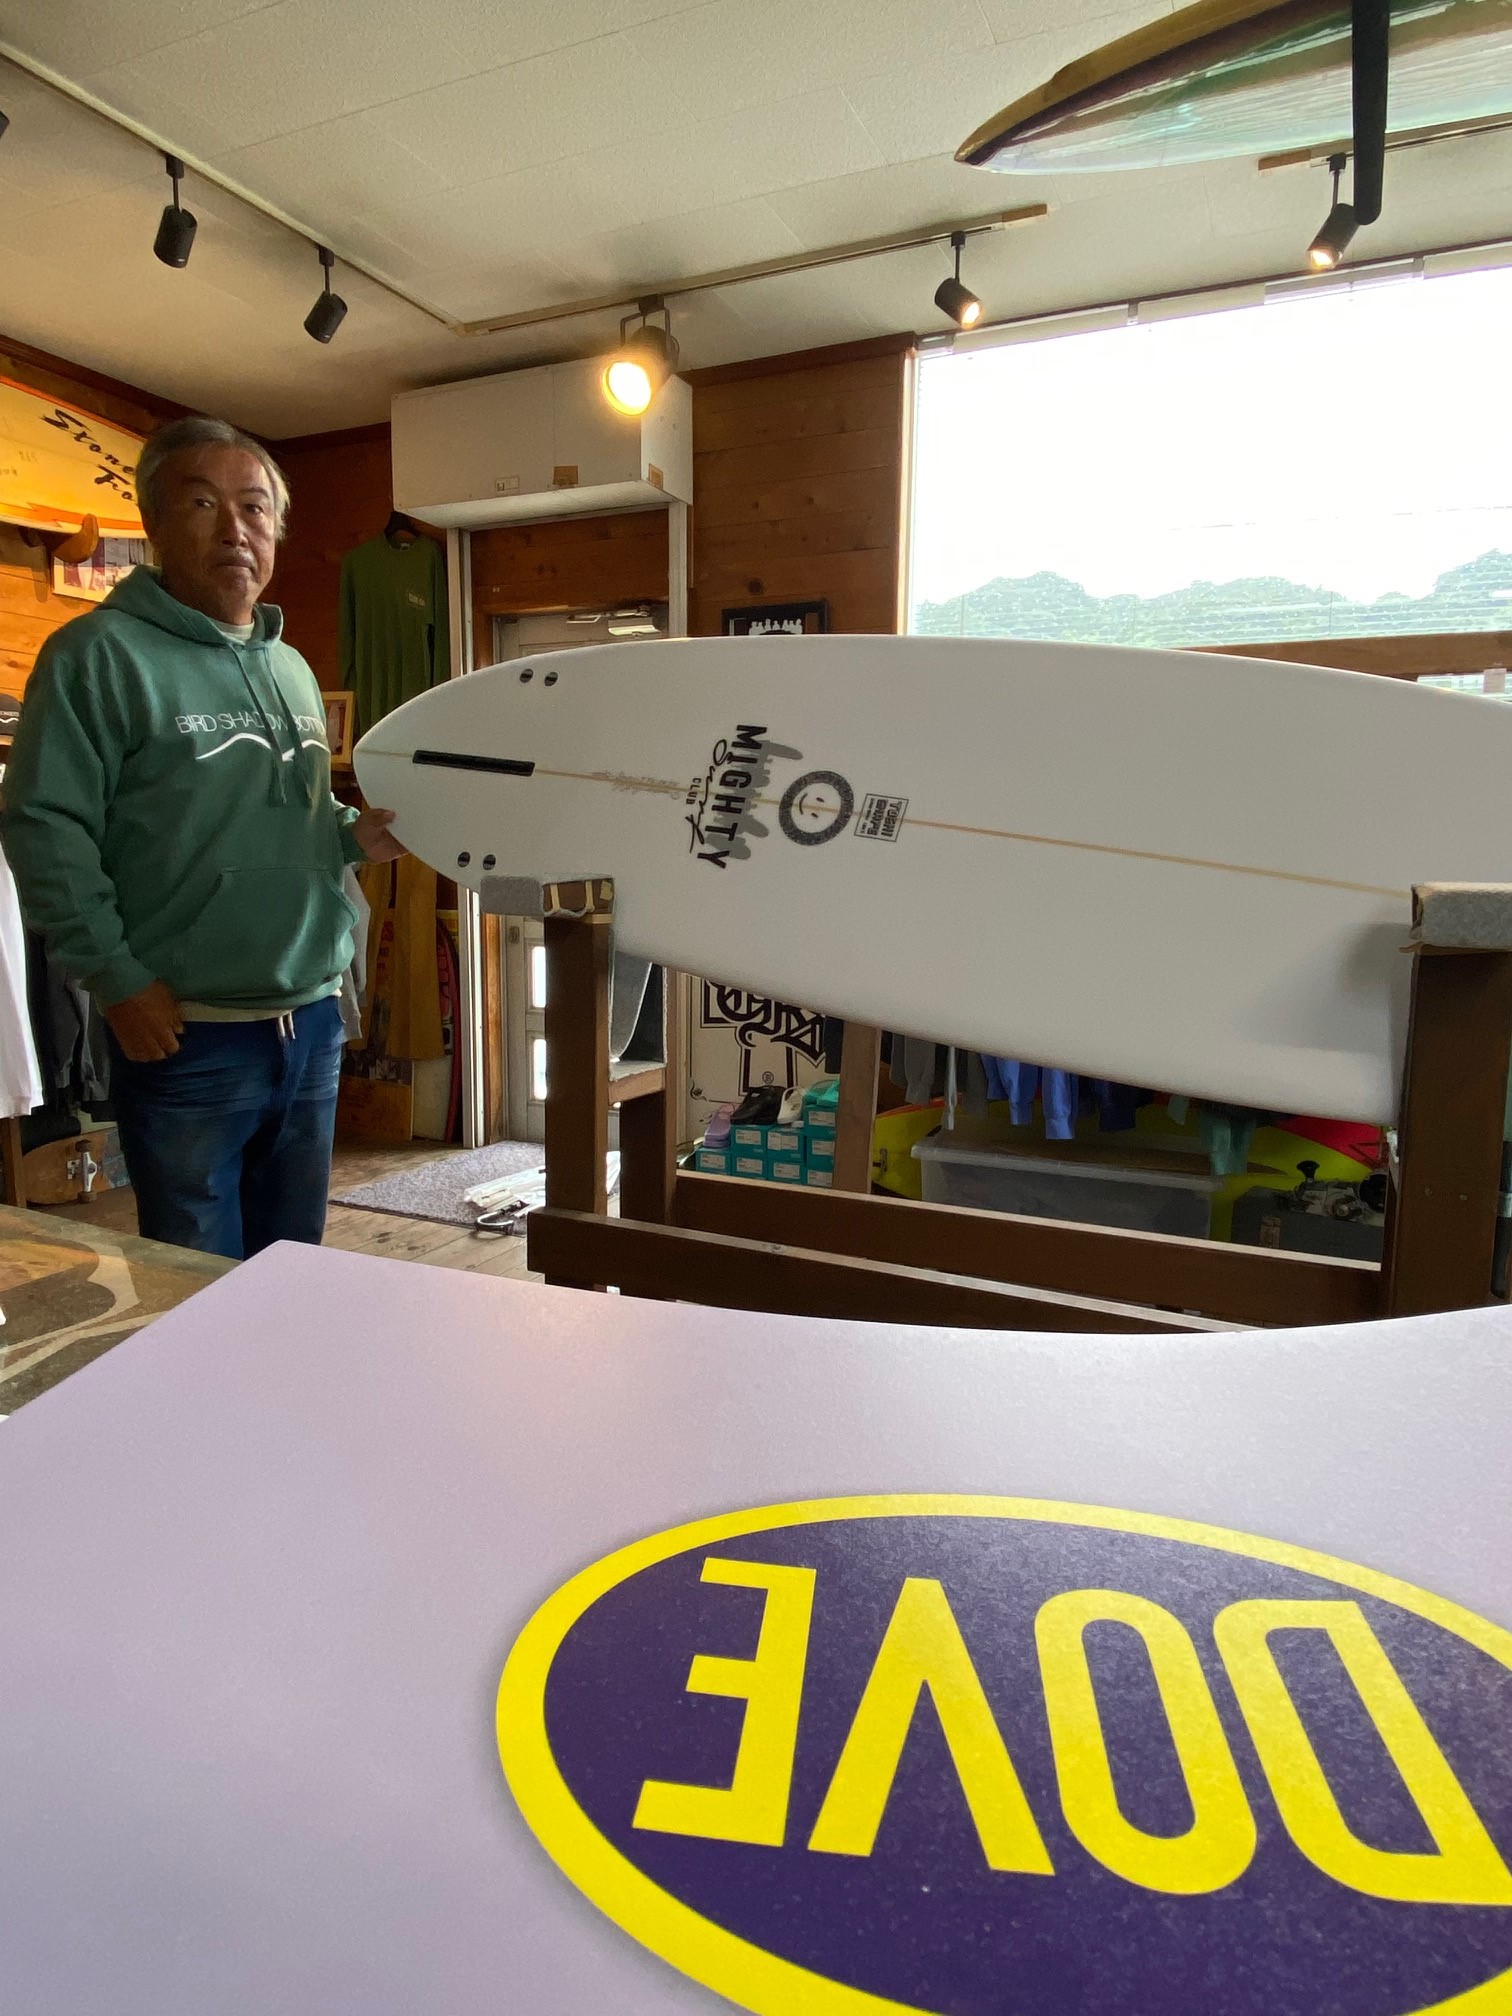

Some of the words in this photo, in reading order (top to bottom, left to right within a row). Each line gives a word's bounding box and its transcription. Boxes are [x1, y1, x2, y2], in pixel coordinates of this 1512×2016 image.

[175, 714, 217, 733] BIRD
[686, 777, 702, 805] CLUB
[697, 724, 768, 869] MIGHTY
[632, 1557, 1512, 1906] DOVE
